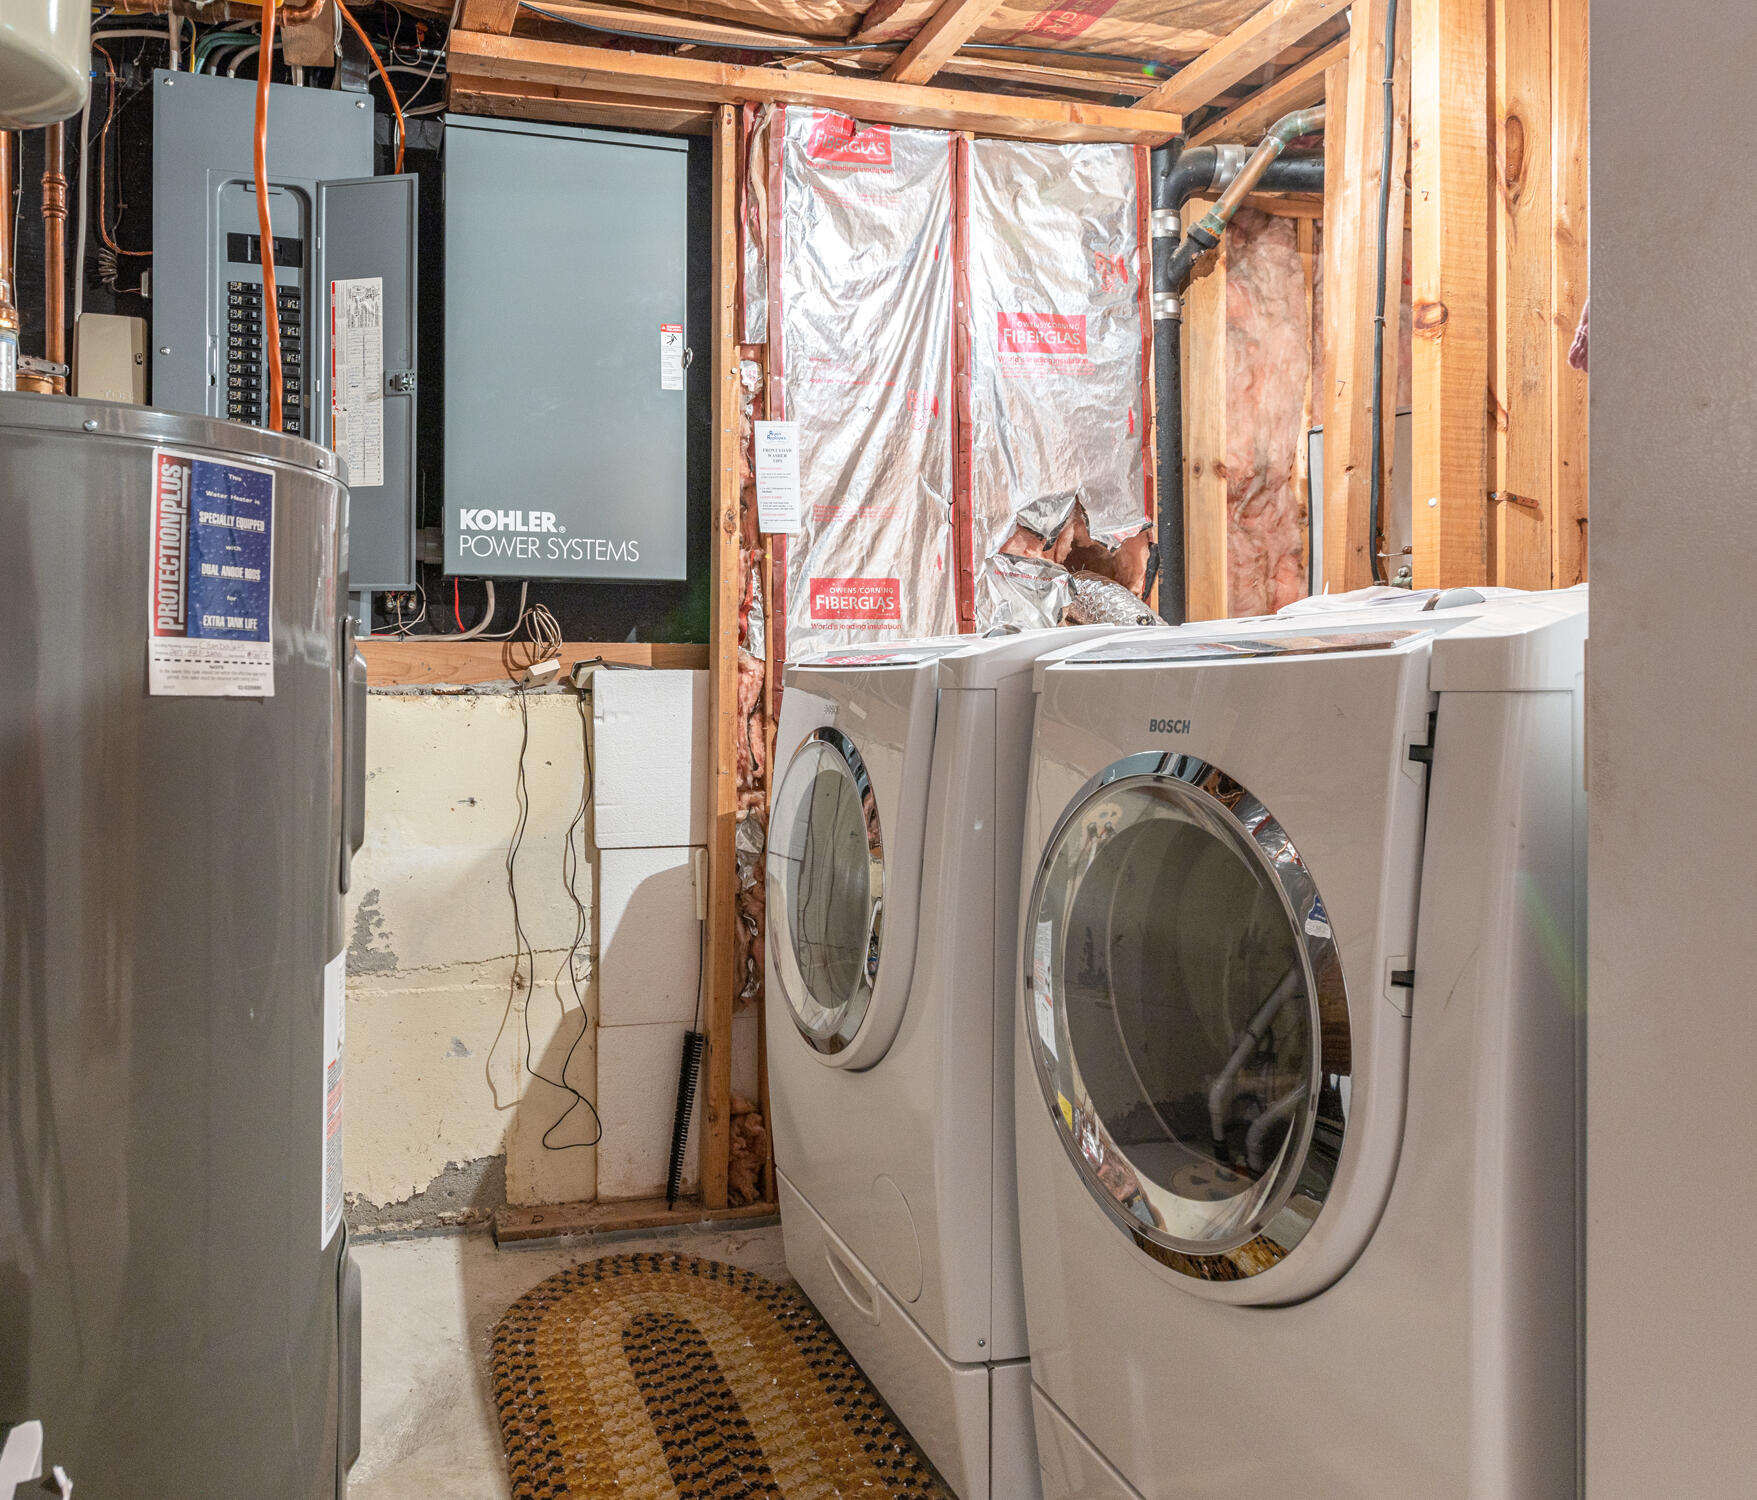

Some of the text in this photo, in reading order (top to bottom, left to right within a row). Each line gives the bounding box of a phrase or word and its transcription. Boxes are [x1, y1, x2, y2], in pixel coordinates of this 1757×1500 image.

[814, 129, 886, 155] FIBERGLAS
[1003, 328, 1081, 345] FIBERGLAS
[228, 473, 242, 482] This
[205, 489, 228, 500] Water
[230, 494, 253, 504] Heater
[199, 510, 265, 532] SPECIALLY EQUIPPED
[459, 508, 558, 533] KOHLER
[225, 544, 242, 552] with
[459, 535, 640, 562] POWER SYSTEMS
[201, 563, 219, 577] DUAL
[221, 565, 244, 579] ANODE
[815, 594, 895, 611] FIBERGLAS
[203, 614, 258, 630] EXTRA TANK LIFE
[811, 622, 902, 631] World's leading insulation
[1149, 719, 1191, 734] BOSCH
